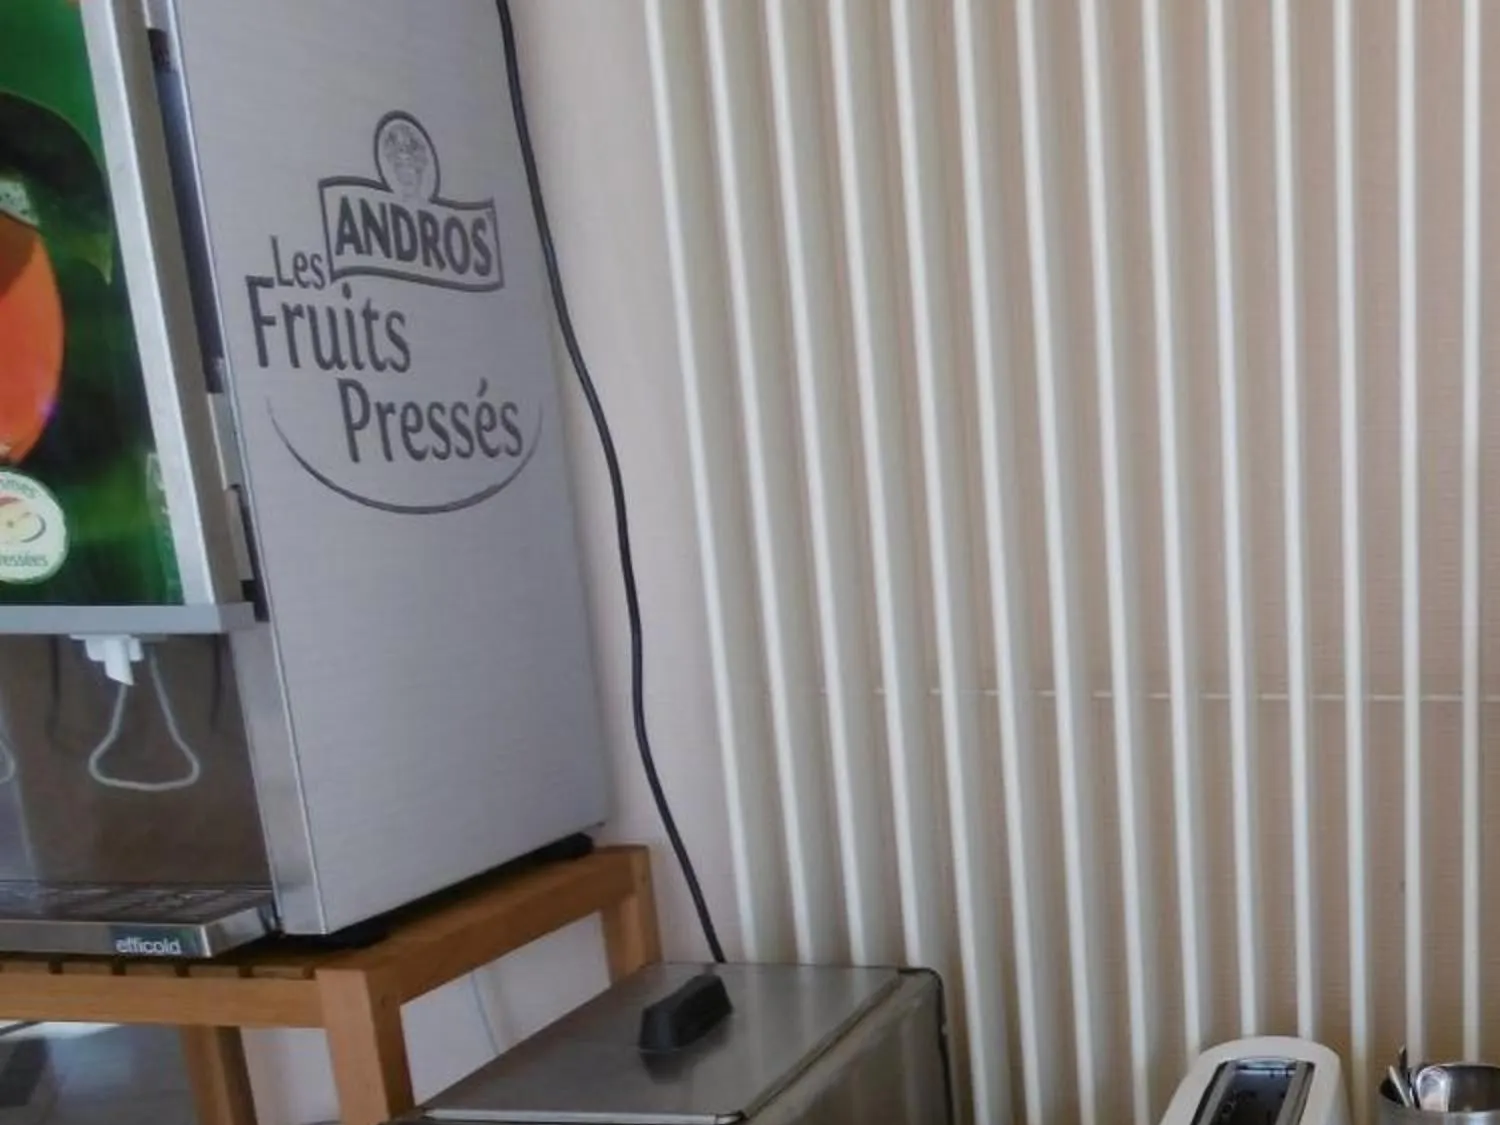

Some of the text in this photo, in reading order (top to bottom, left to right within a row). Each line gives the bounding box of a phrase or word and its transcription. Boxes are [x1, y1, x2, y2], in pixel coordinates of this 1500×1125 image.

[270, 234, 326, 290] Les
[335, 195, 493, 277] ANDROS
[246, 275, 411, 373] Fruits
[336, 377, 523, 463] Pressés
